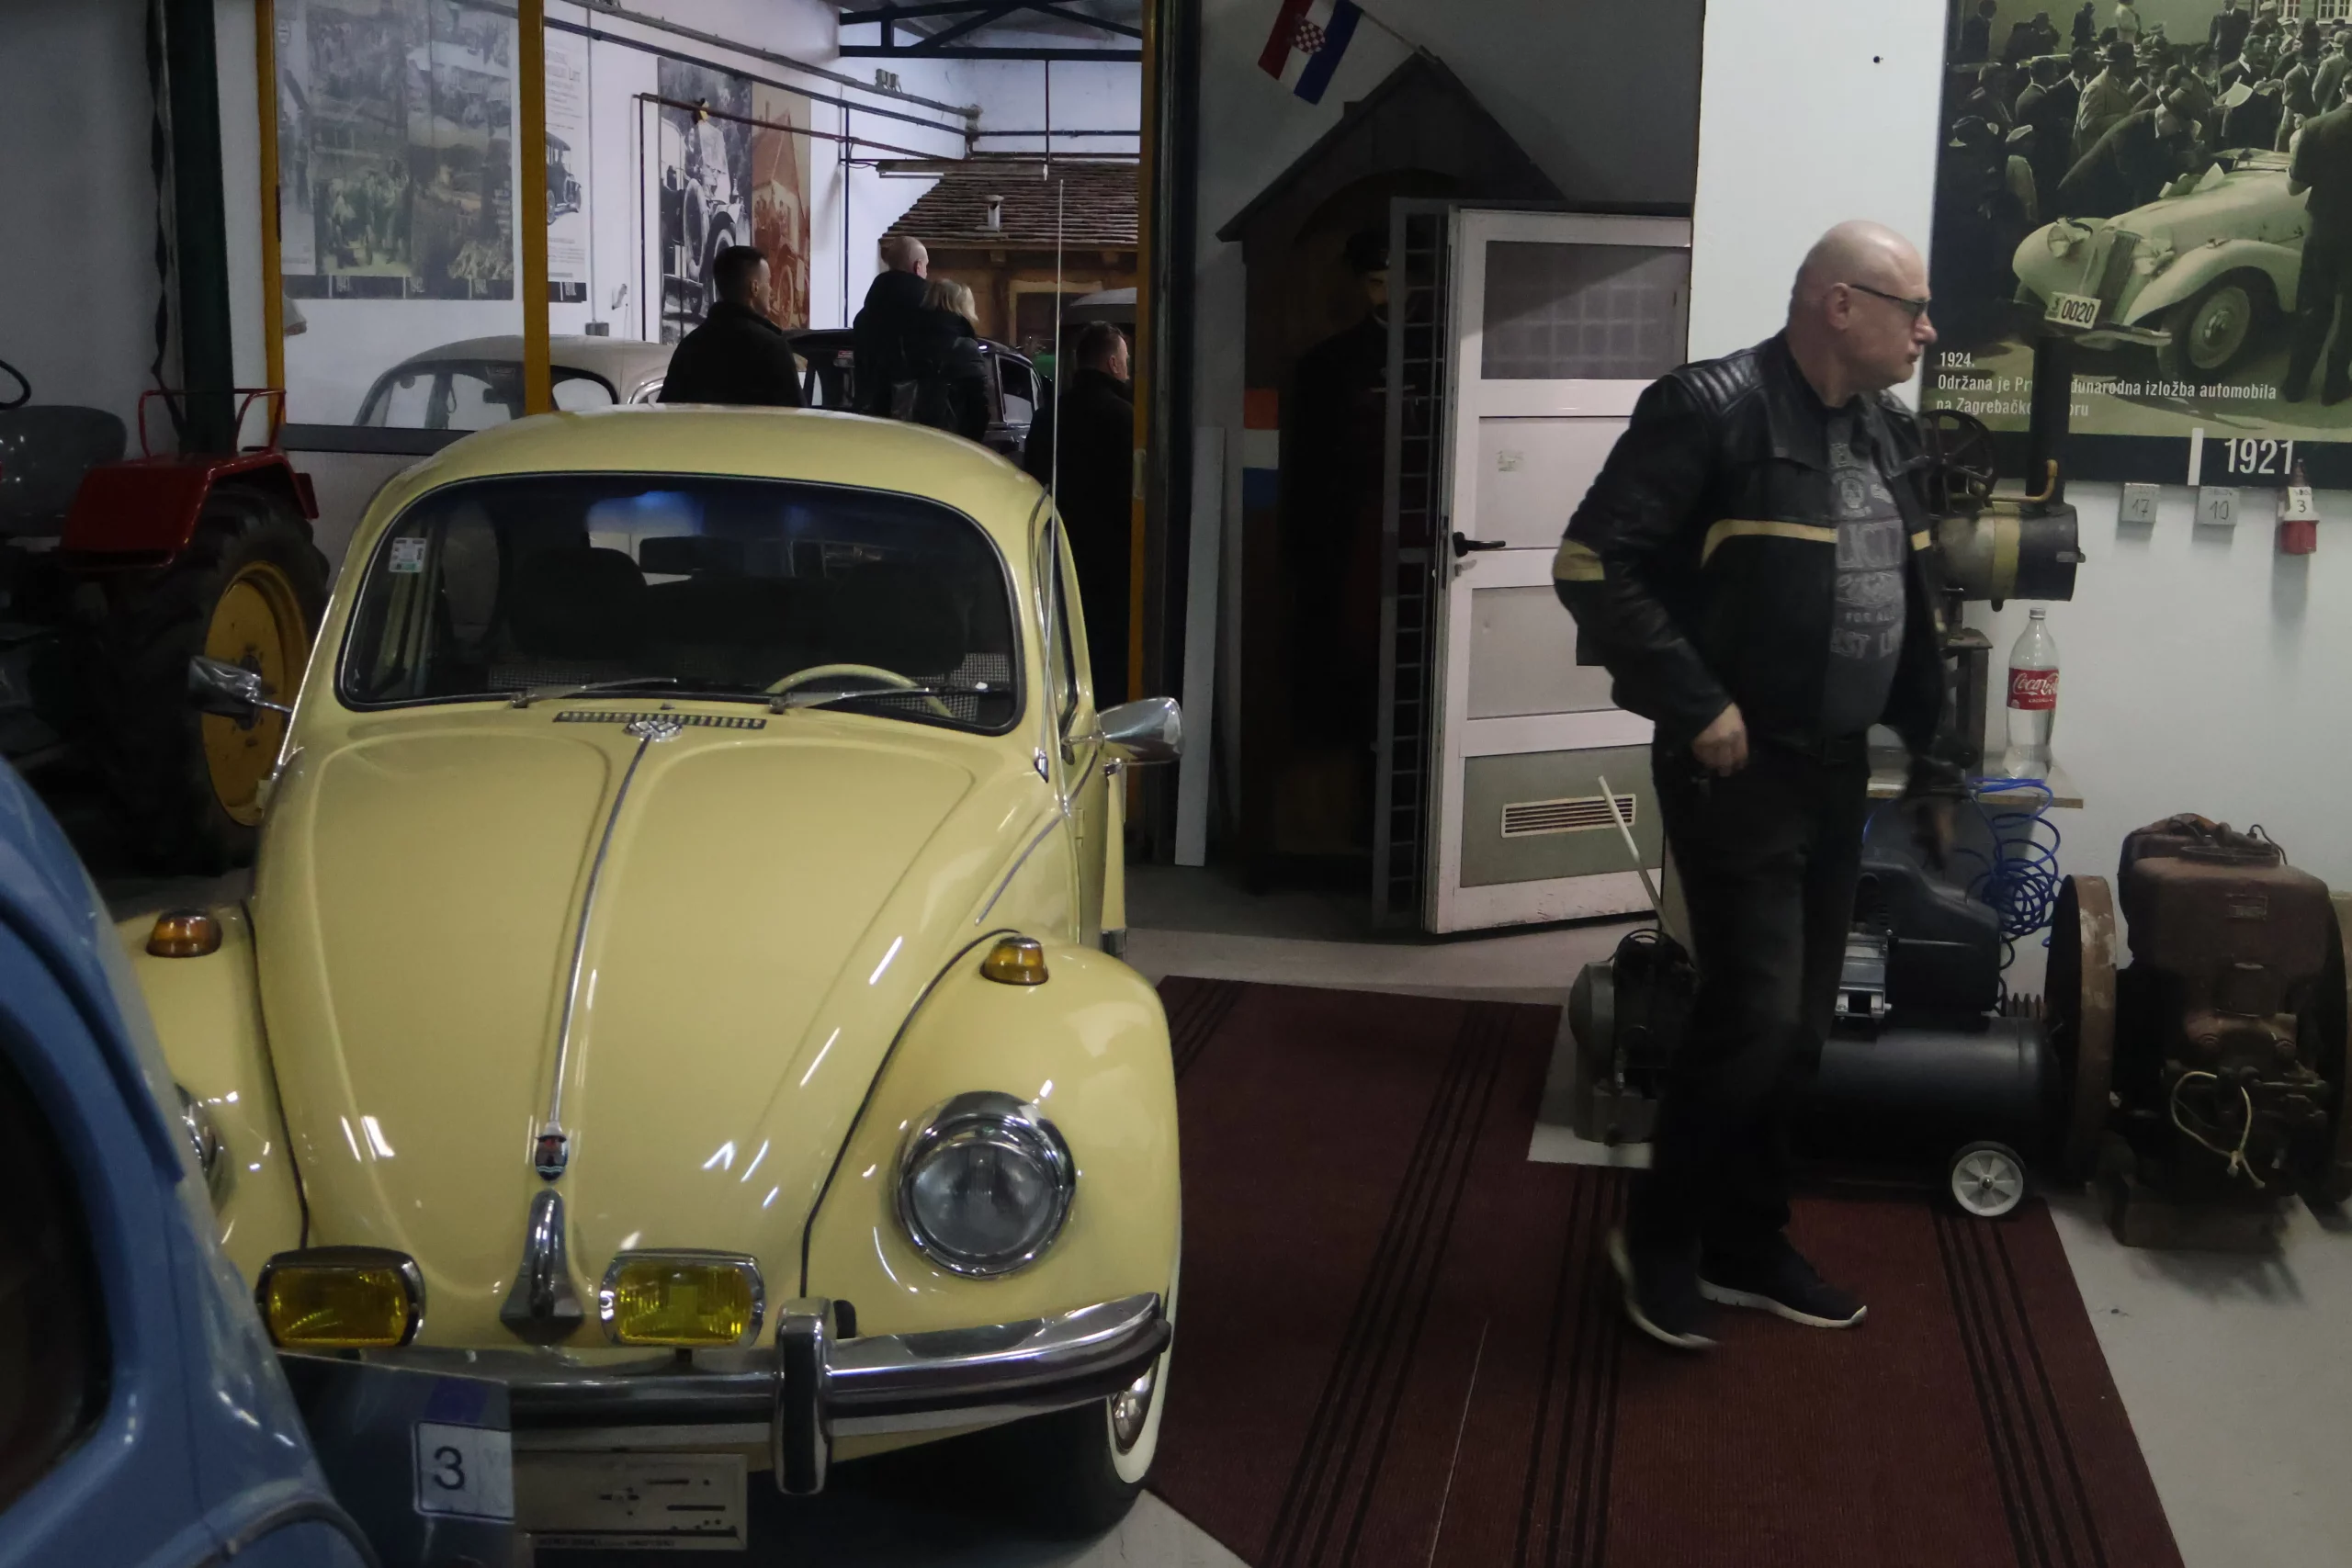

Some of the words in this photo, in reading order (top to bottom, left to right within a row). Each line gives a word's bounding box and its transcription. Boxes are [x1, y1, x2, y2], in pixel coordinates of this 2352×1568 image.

[2061, 299, 2095, 324] 0020
[1939, 351, 1975, 368] 1924.
[1938, 374, 1993, 391] Održana
[1996, 376, 2010, 393] je
[2071, 378, 2142, 396] đunarodna
[2145, 380, 2195, 397] izložba
[2199, 382, 2277, 400] automobila
[1936, 399, 1951, 411] na
[1956, 397, 2031, 415] Zagrebačko
[2224, 437, 2294, 475] 1921
[2132, 498, 2150, 516] 17
[2209, 500, 2230, 520] 10
[2297, 499, 2307, 513] 3
[434, 1445, 465, 1491] 3
